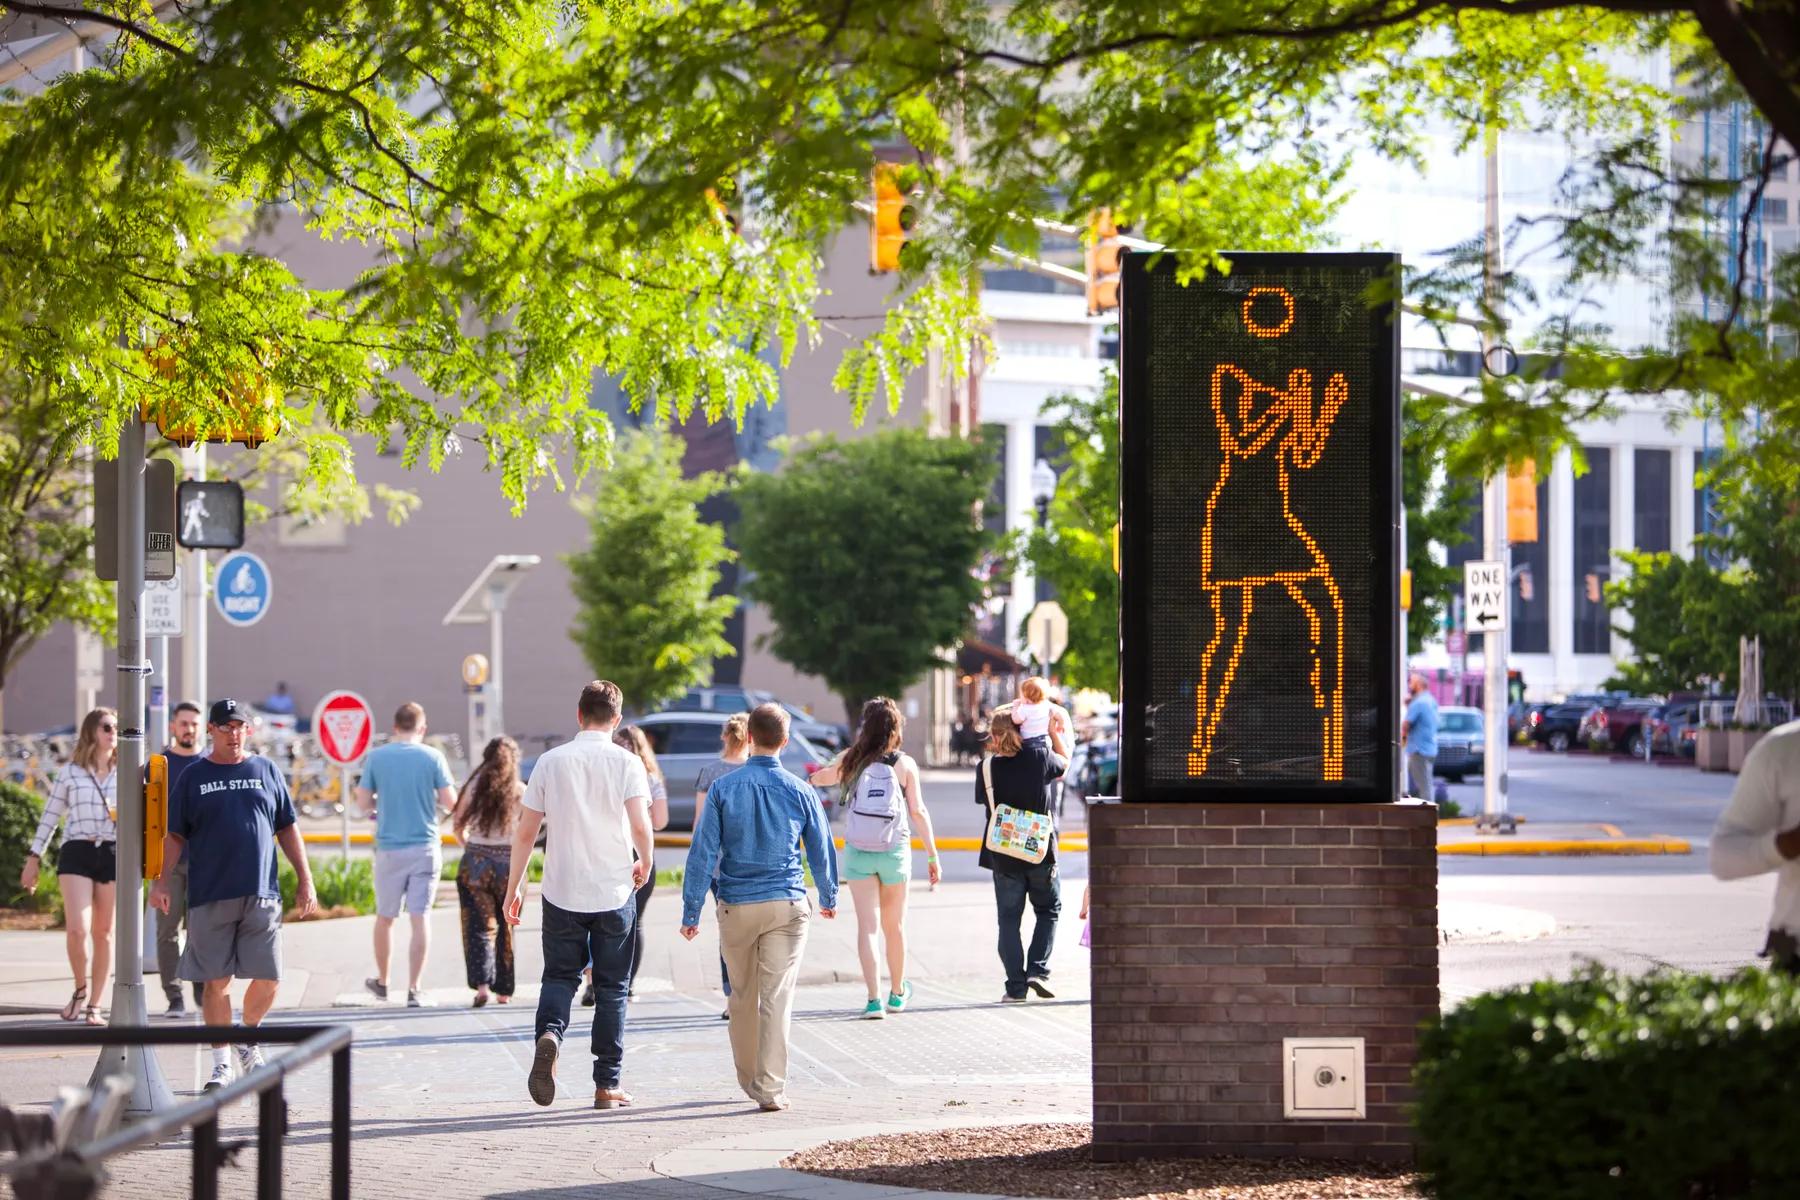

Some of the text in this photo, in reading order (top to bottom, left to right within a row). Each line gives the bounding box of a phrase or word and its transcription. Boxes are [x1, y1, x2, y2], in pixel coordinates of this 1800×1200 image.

[150, 533, 171, 541] LUTER
[1471, 568, 1500, 586] ONE
[152, 594, 169, 604] USE
[1471, 591, 1502, 606] WAY
[152, 606, 170, 617] PED
[226, 699, 236, 710] P
[200, 779, 263, 795] BALL STATE
